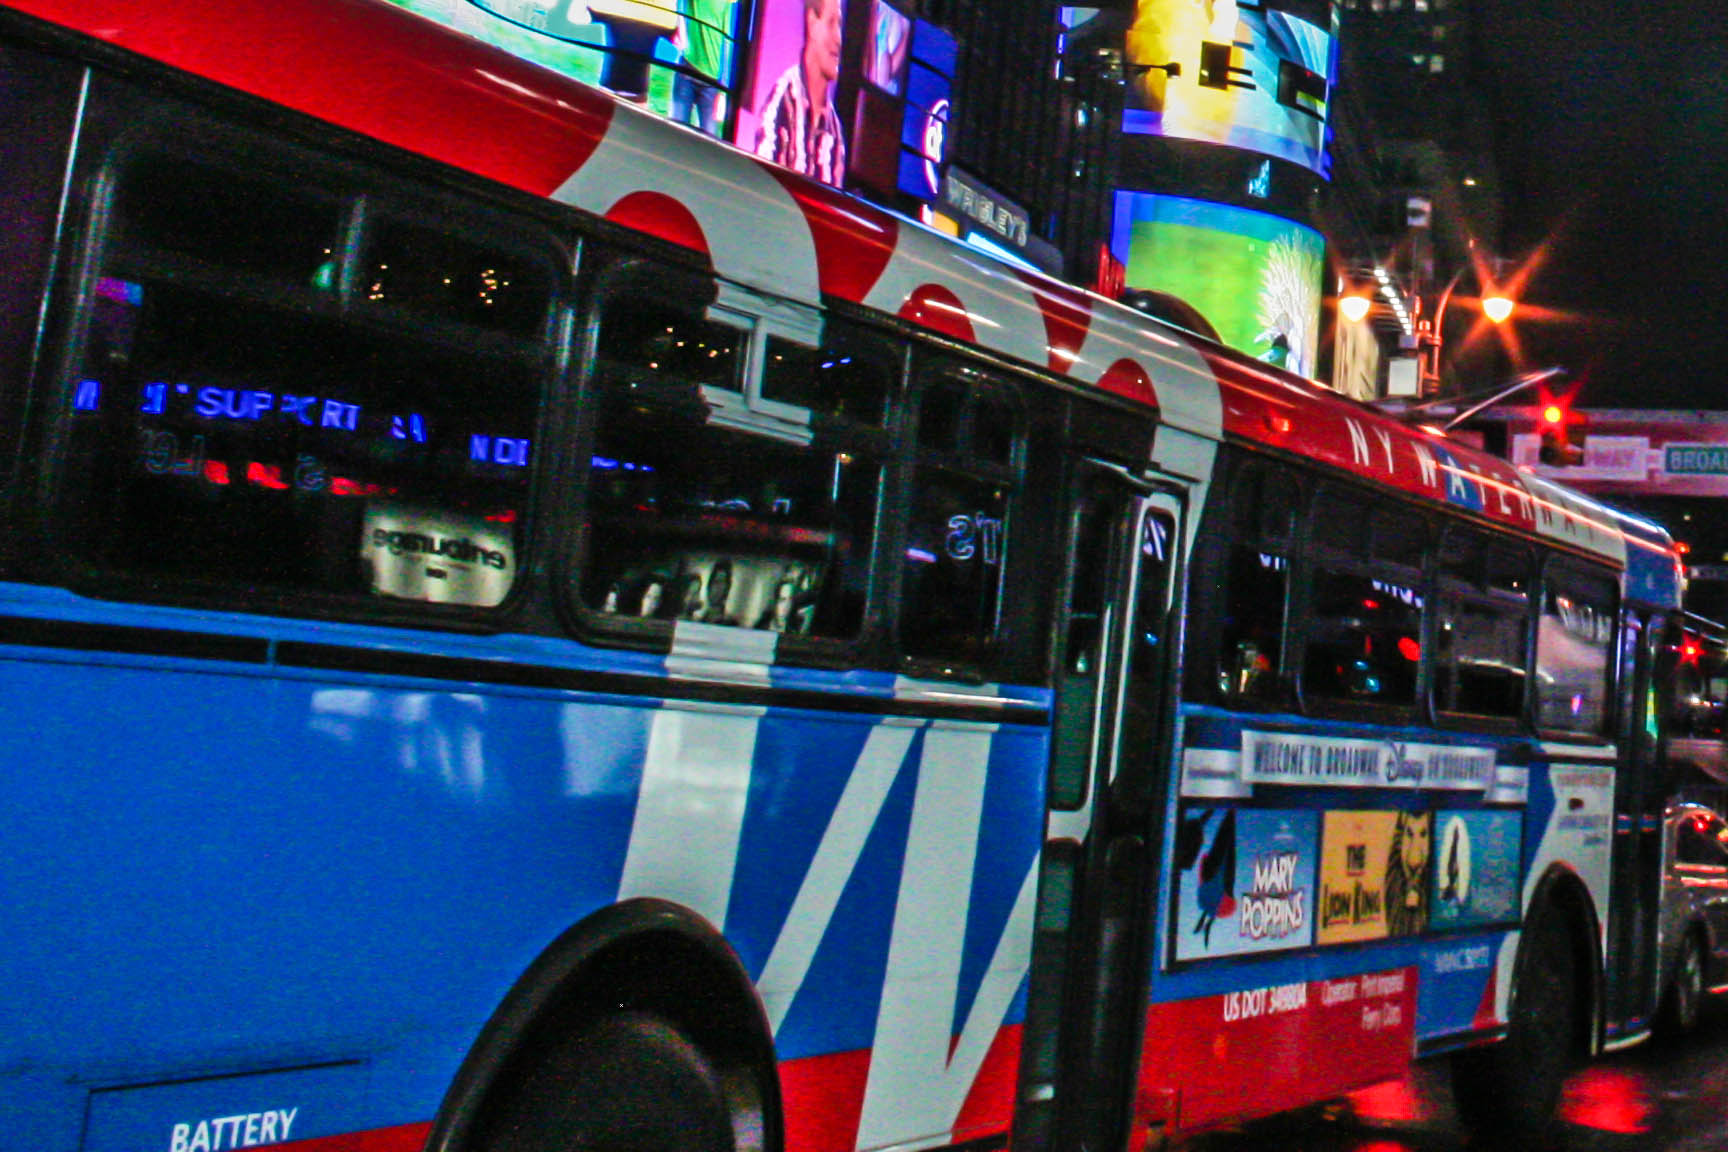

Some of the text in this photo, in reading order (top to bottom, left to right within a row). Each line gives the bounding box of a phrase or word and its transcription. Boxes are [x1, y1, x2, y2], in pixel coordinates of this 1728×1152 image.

[1345, 416, 1394, 474] NY
[1255, 742, 1304, 775] WELCOME
[1310, 745, 1322, 775] TO
[1327, 745, 1380, 776] BROADWAY
[1252, 854, 1298, 893] MARY
[1346, 844, 1366, 869] THE
[1240, 890, 1304, 940] POPPINS
[1224, 992, 1240, 1022] US
[1242, 988, 1267, 1019] DOT
[170, 1107, 299, 1152] BATTERY
